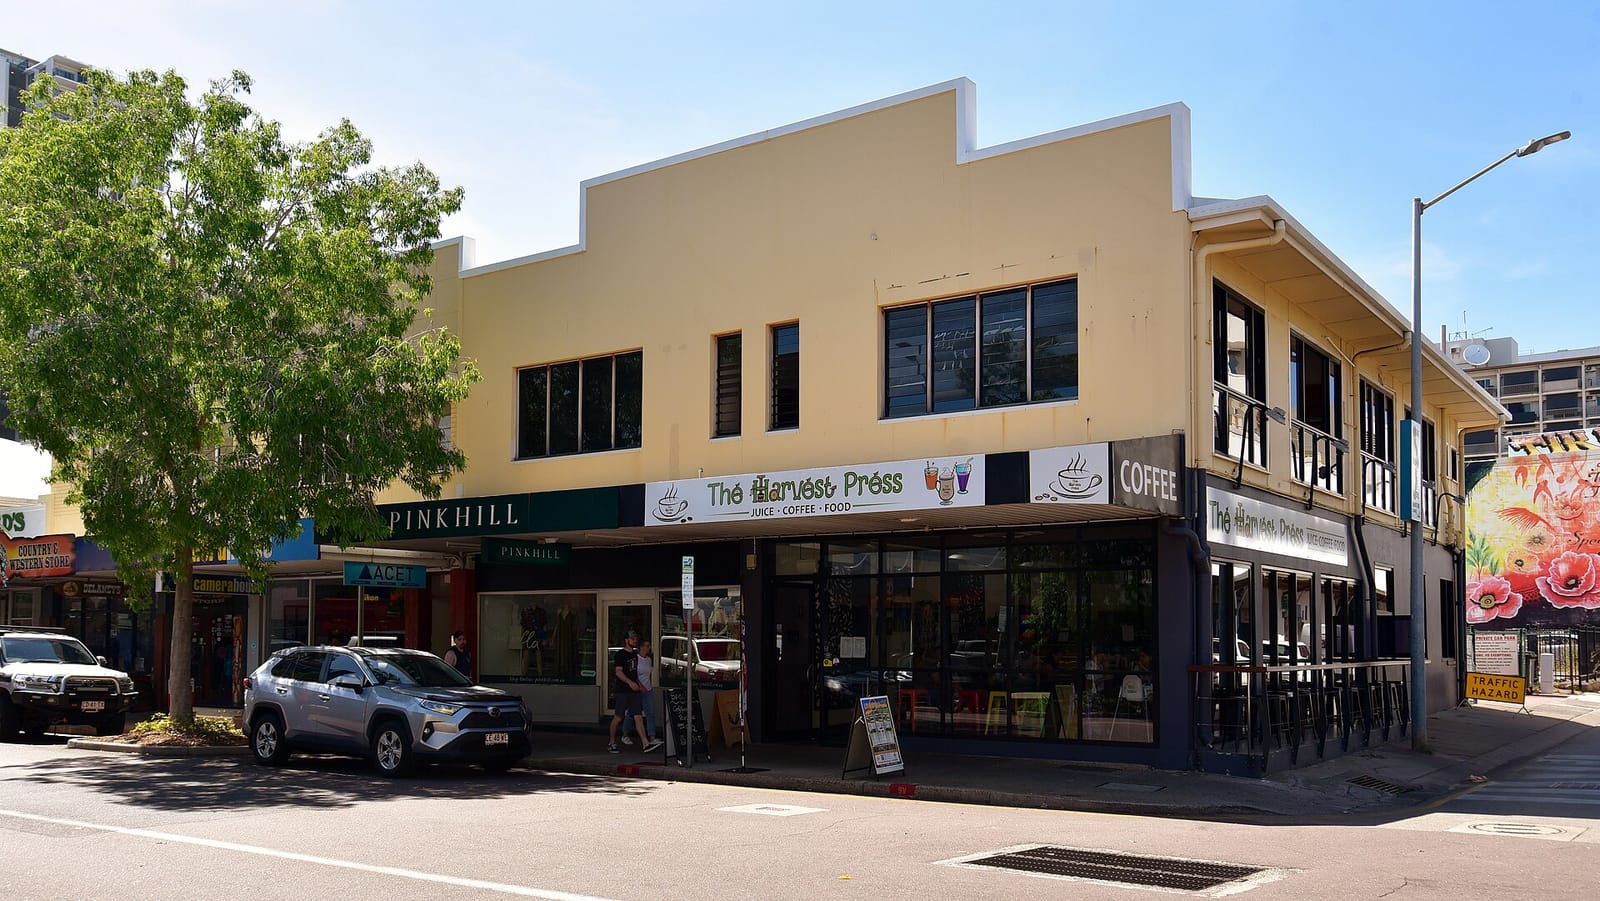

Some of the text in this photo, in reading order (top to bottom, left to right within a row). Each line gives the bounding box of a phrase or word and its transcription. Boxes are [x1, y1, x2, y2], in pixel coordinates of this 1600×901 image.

[1508, 430, 1600, 456] TIK
[707, 471, 903, 506] The Harvest Press
[1120, 459, 1177, 502] COFFEE
[750, 502, 851, 517] JUICE COFFEE FOOD
[0, 512, 25, 531] D'S
[390, 503, 518, 534] PINKHILL
[1209, 500, 1304, 546] The Harvest Press
[18, 543, 58, 557] COUNTRY &
[501, 546, 560, 560] PINKHILL
[10, 556, 70, 570] WESTERN STORE
[374, 566, 414, 582] ACET
[1473, 676, 1519, 689] TRAFFIC
[1471, 687, 1518, 699] HAZARD
